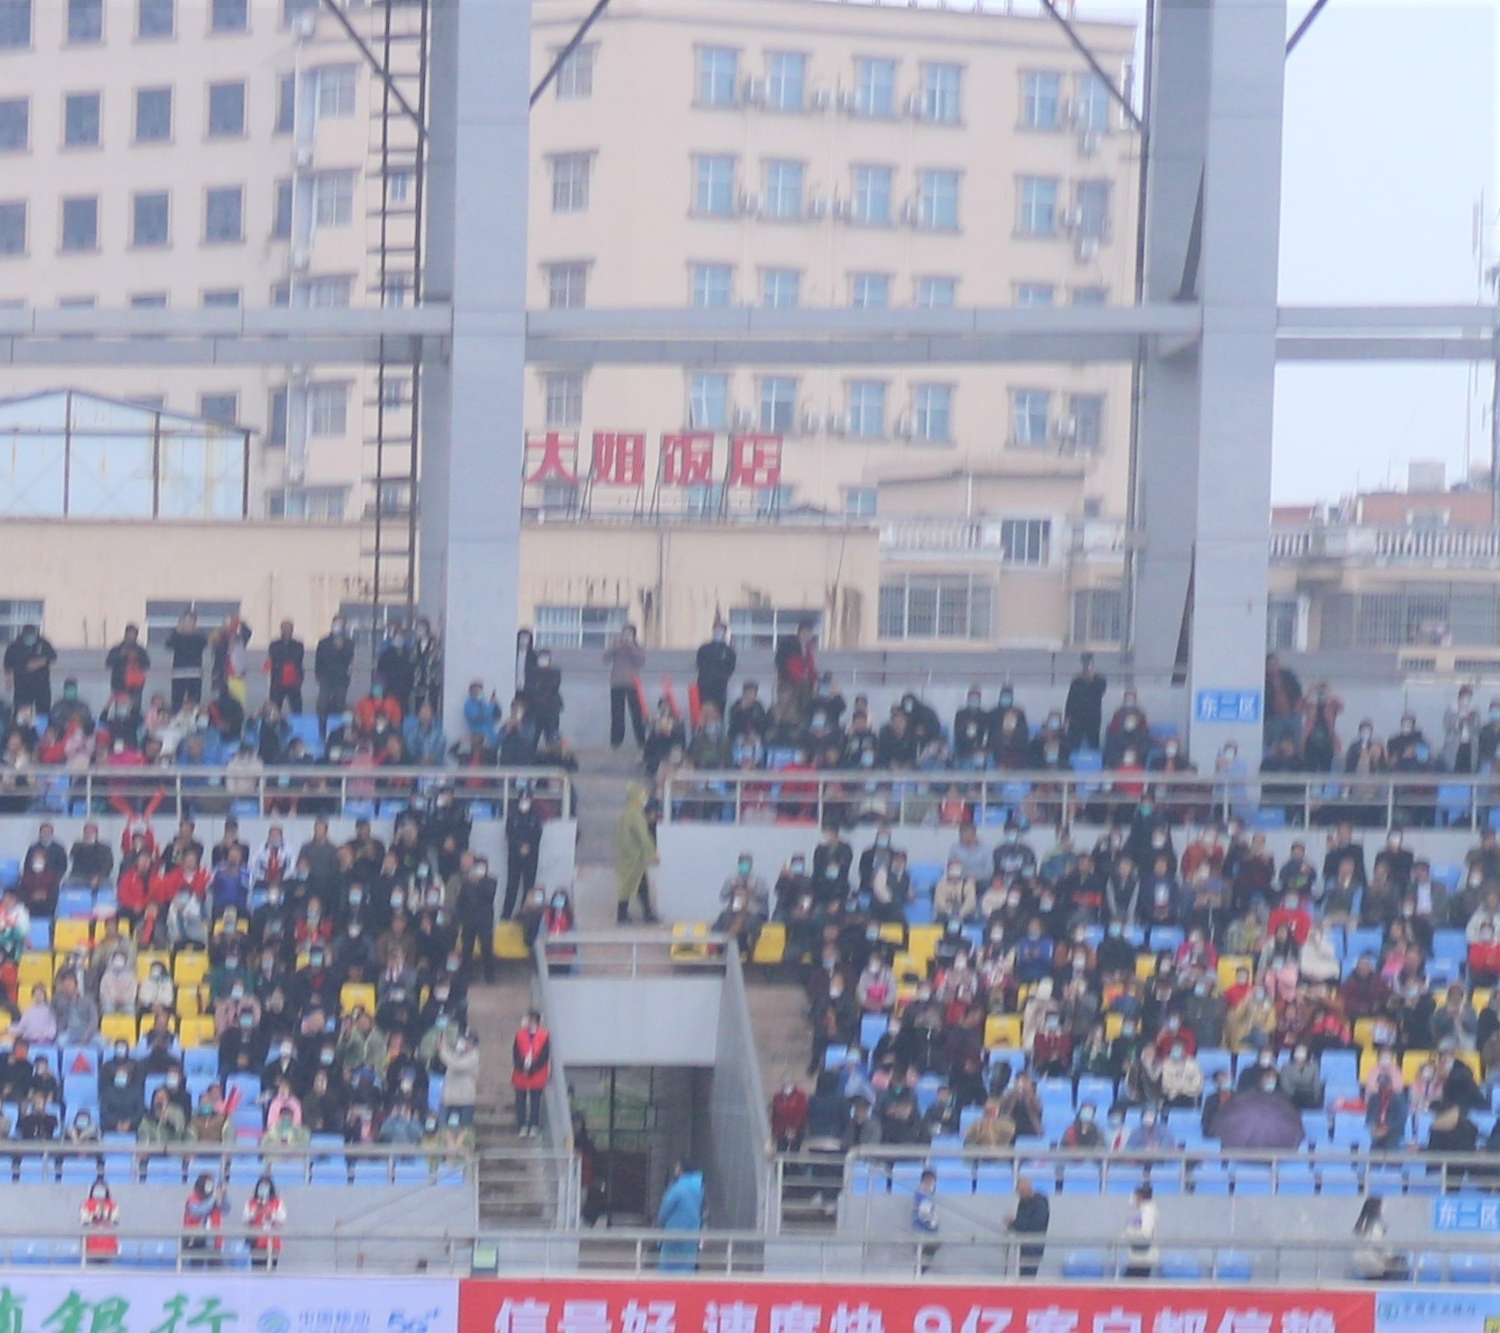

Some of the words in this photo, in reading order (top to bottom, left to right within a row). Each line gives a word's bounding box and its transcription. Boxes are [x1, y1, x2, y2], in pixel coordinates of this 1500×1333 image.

[1199, 692, 1256, 717] 东二区
[1438, 1200, 1500, 1226] 东二区
